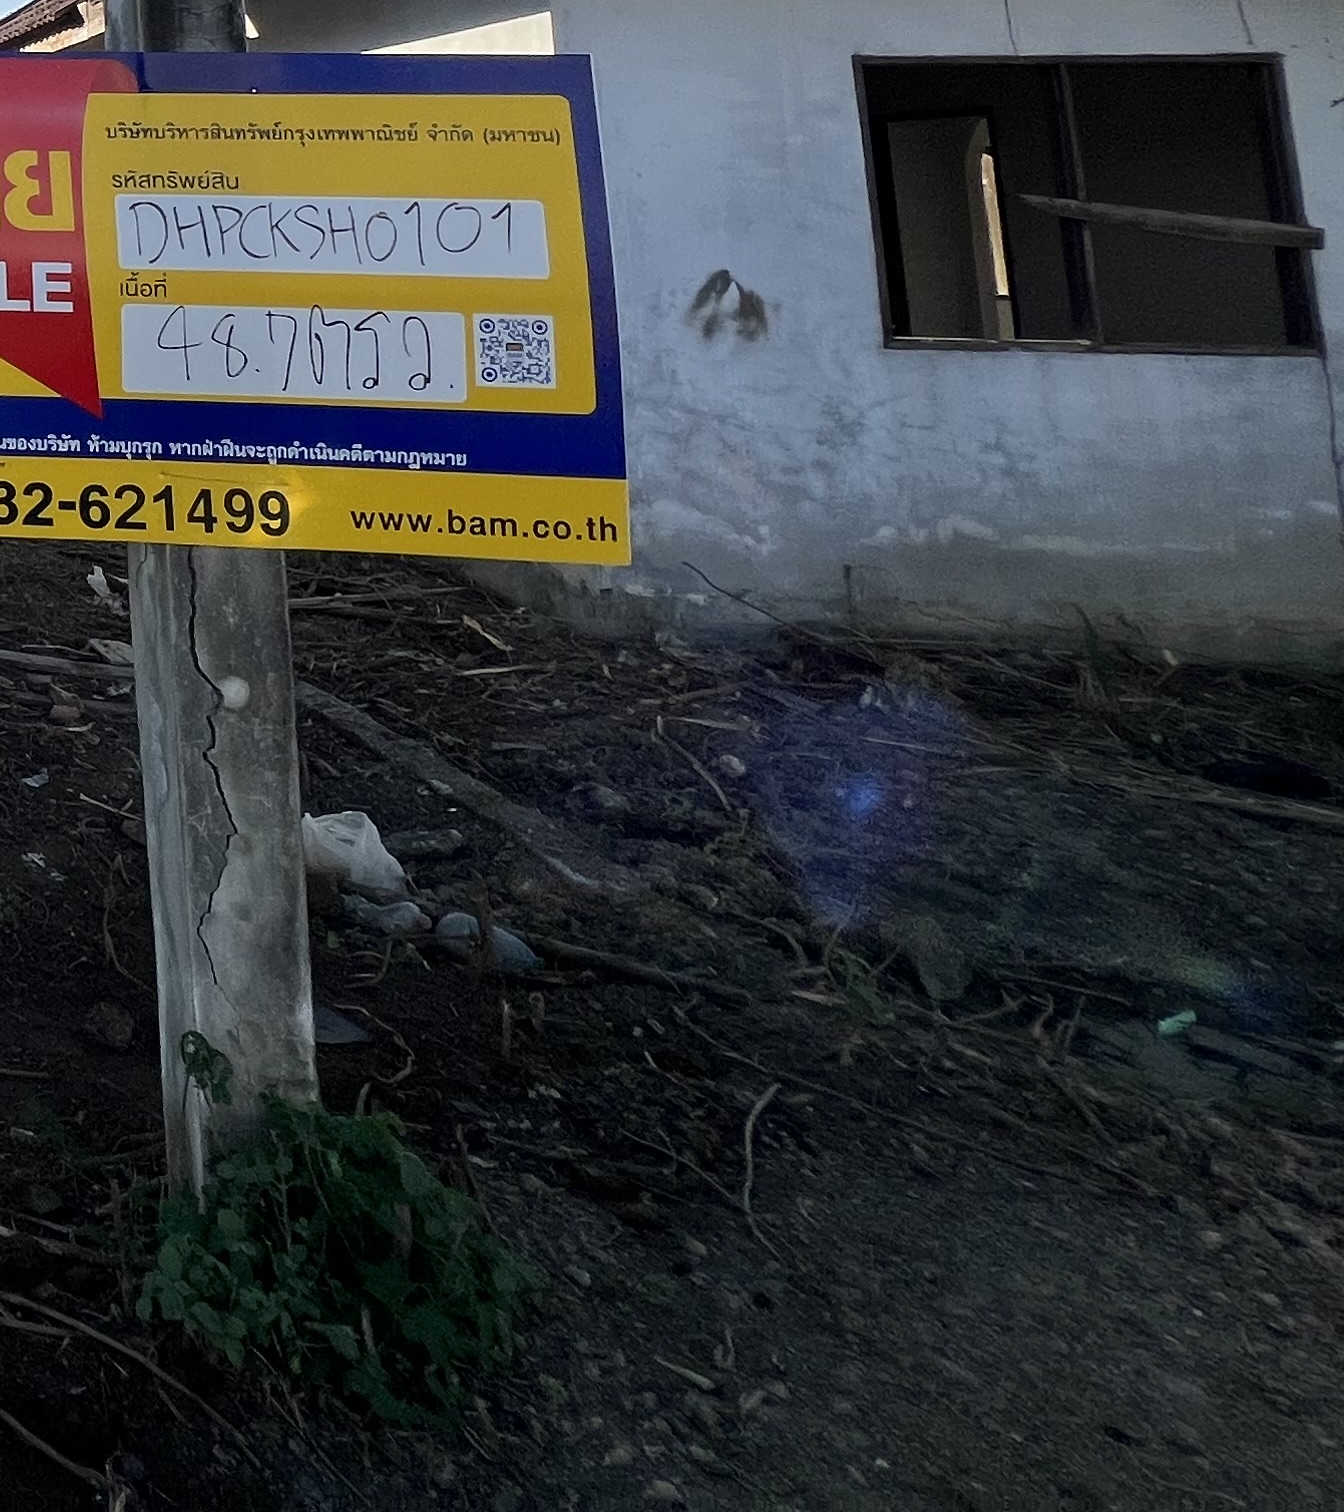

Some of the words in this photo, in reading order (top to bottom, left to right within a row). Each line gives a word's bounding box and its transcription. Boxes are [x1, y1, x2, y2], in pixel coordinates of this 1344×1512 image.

[427, 123, 474, 142] จำกัด
[483, 127, 561, 145] (มหาชน)
[112, 170, 239, 190] รหัสทรัพย์สิน
[119, 272, 167, 299] เนื้อที่
[87, 434, 162, 461] ห้ามบุกรุก
[351, 507, 618, 543] www.bam.co.th
